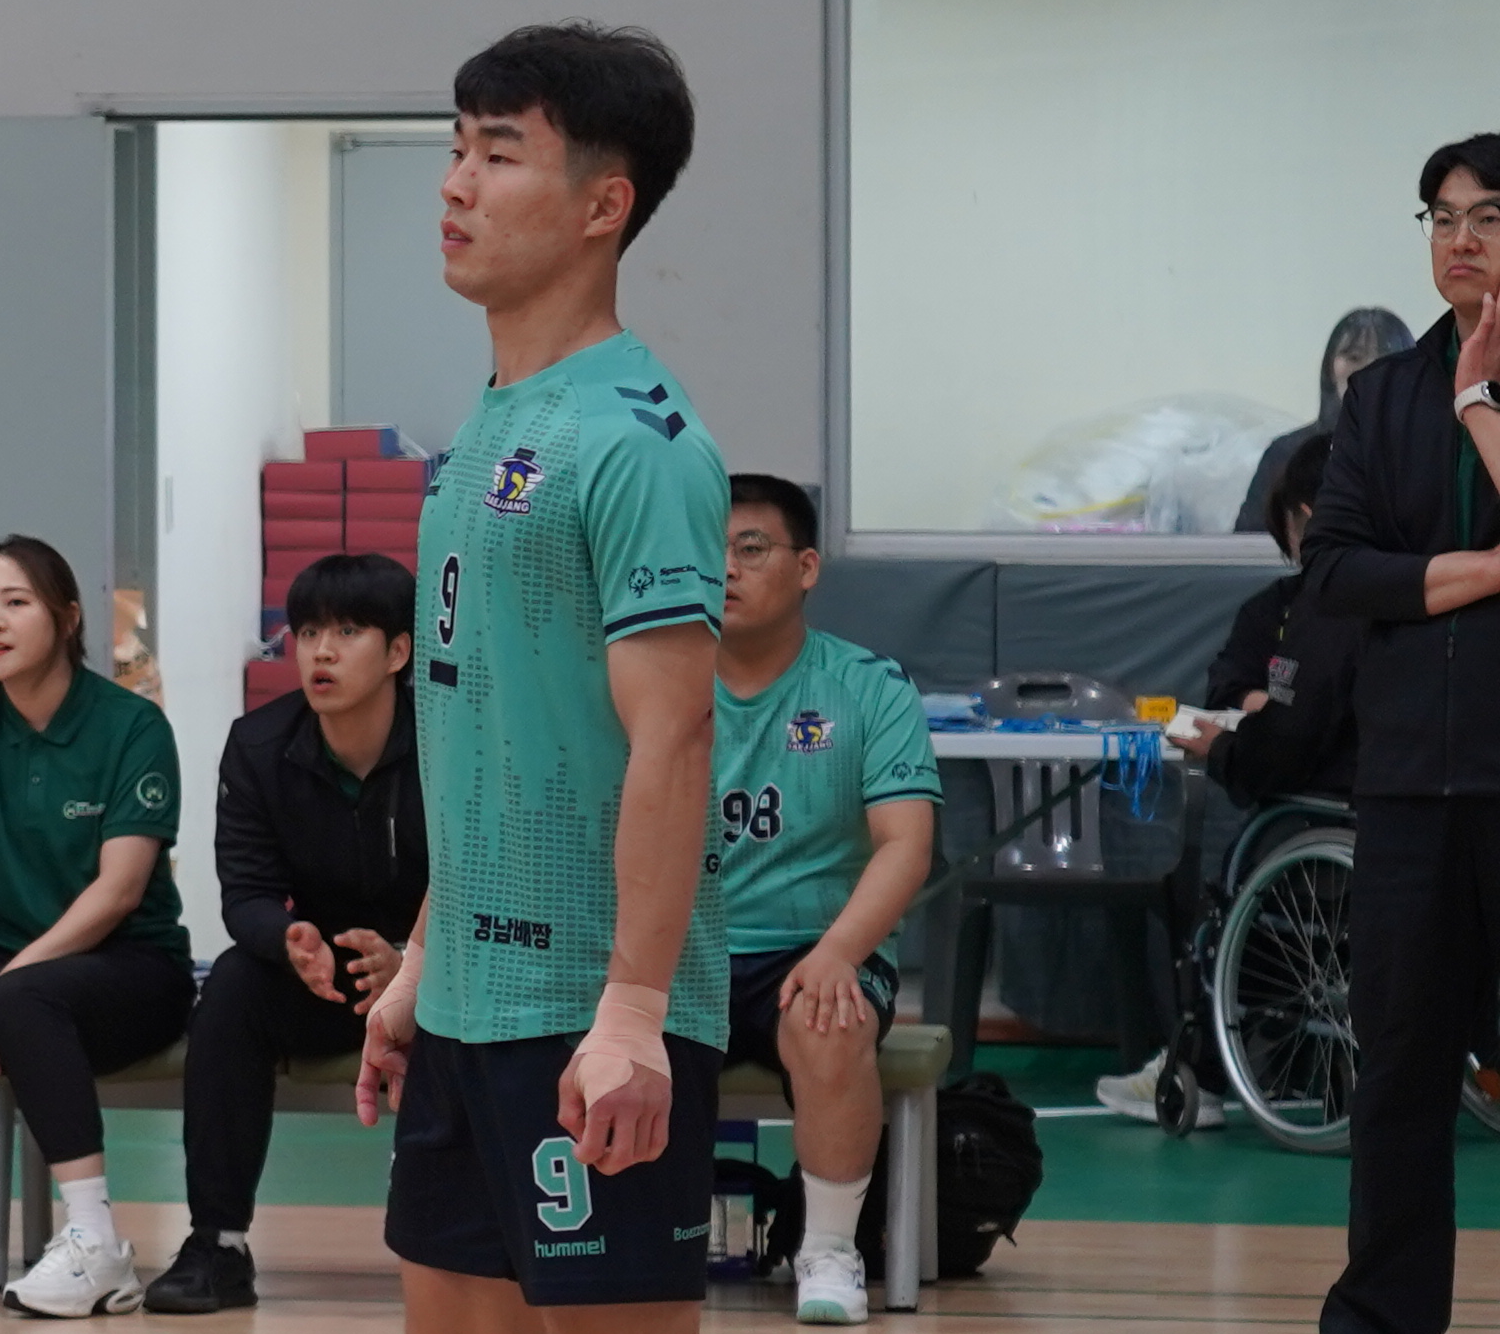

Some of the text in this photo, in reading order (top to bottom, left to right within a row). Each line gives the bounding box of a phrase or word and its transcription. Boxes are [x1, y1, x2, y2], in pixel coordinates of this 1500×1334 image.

[436, 552, 462, 649] 9
[720, 782, 783, 847] 98
[473, 912, 553, 951] 경남배짱
[532, 1136, 593, 1232] 9
[534, 1234, 606, 1258] hummel
